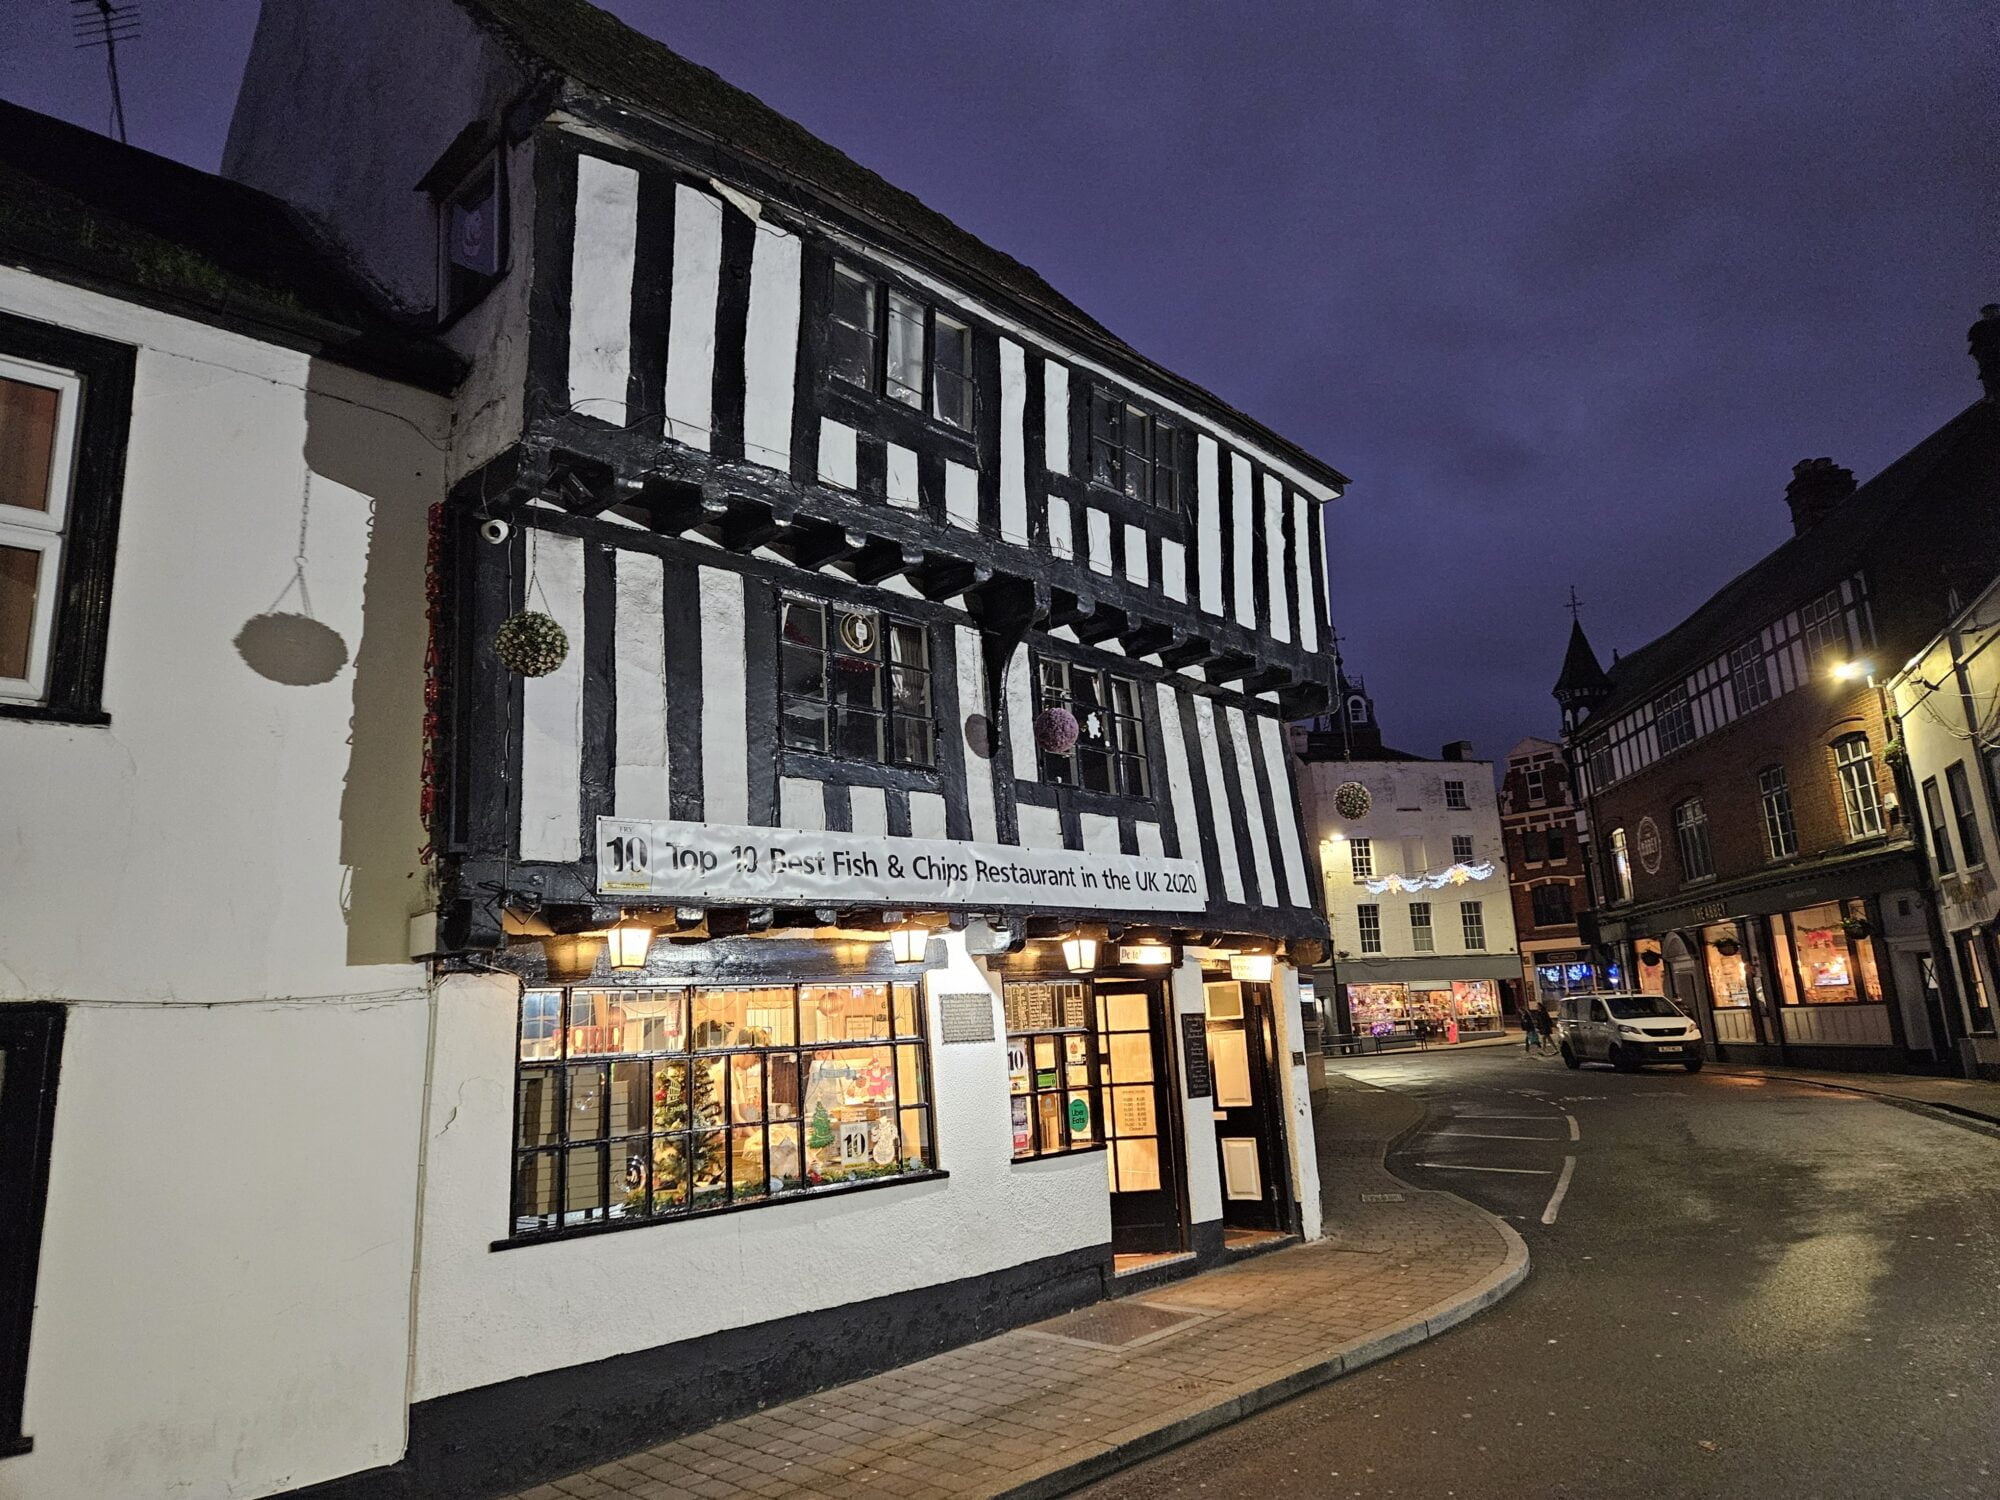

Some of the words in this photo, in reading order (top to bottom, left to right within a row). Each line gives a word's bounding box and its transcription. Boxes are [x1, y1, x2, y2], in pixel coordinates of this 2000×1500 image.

[606, 836, 648, 873] 10
[665, 841, 718, 878] Top
[731, 845, 758, 873] 10
[771, 847, 825, 876] Best
[833, 850, 879, 878] Fish
[887, 853, 905, 879] &
[912, 855, 968, 887] Chips
[976, 859, 1077, 888] Restaurant
[1081, 865, 1098, 889] in
[1102, 868, 1131, 891] the
[1136, 871, 1160, 892] UK
[1163, 872, 1197, 894] 2020
[1008, 1049, 1024, 1071] 10
[1072, 1117, 1086, 1125] Eats
[843, 1132, 866, 1159] 10
